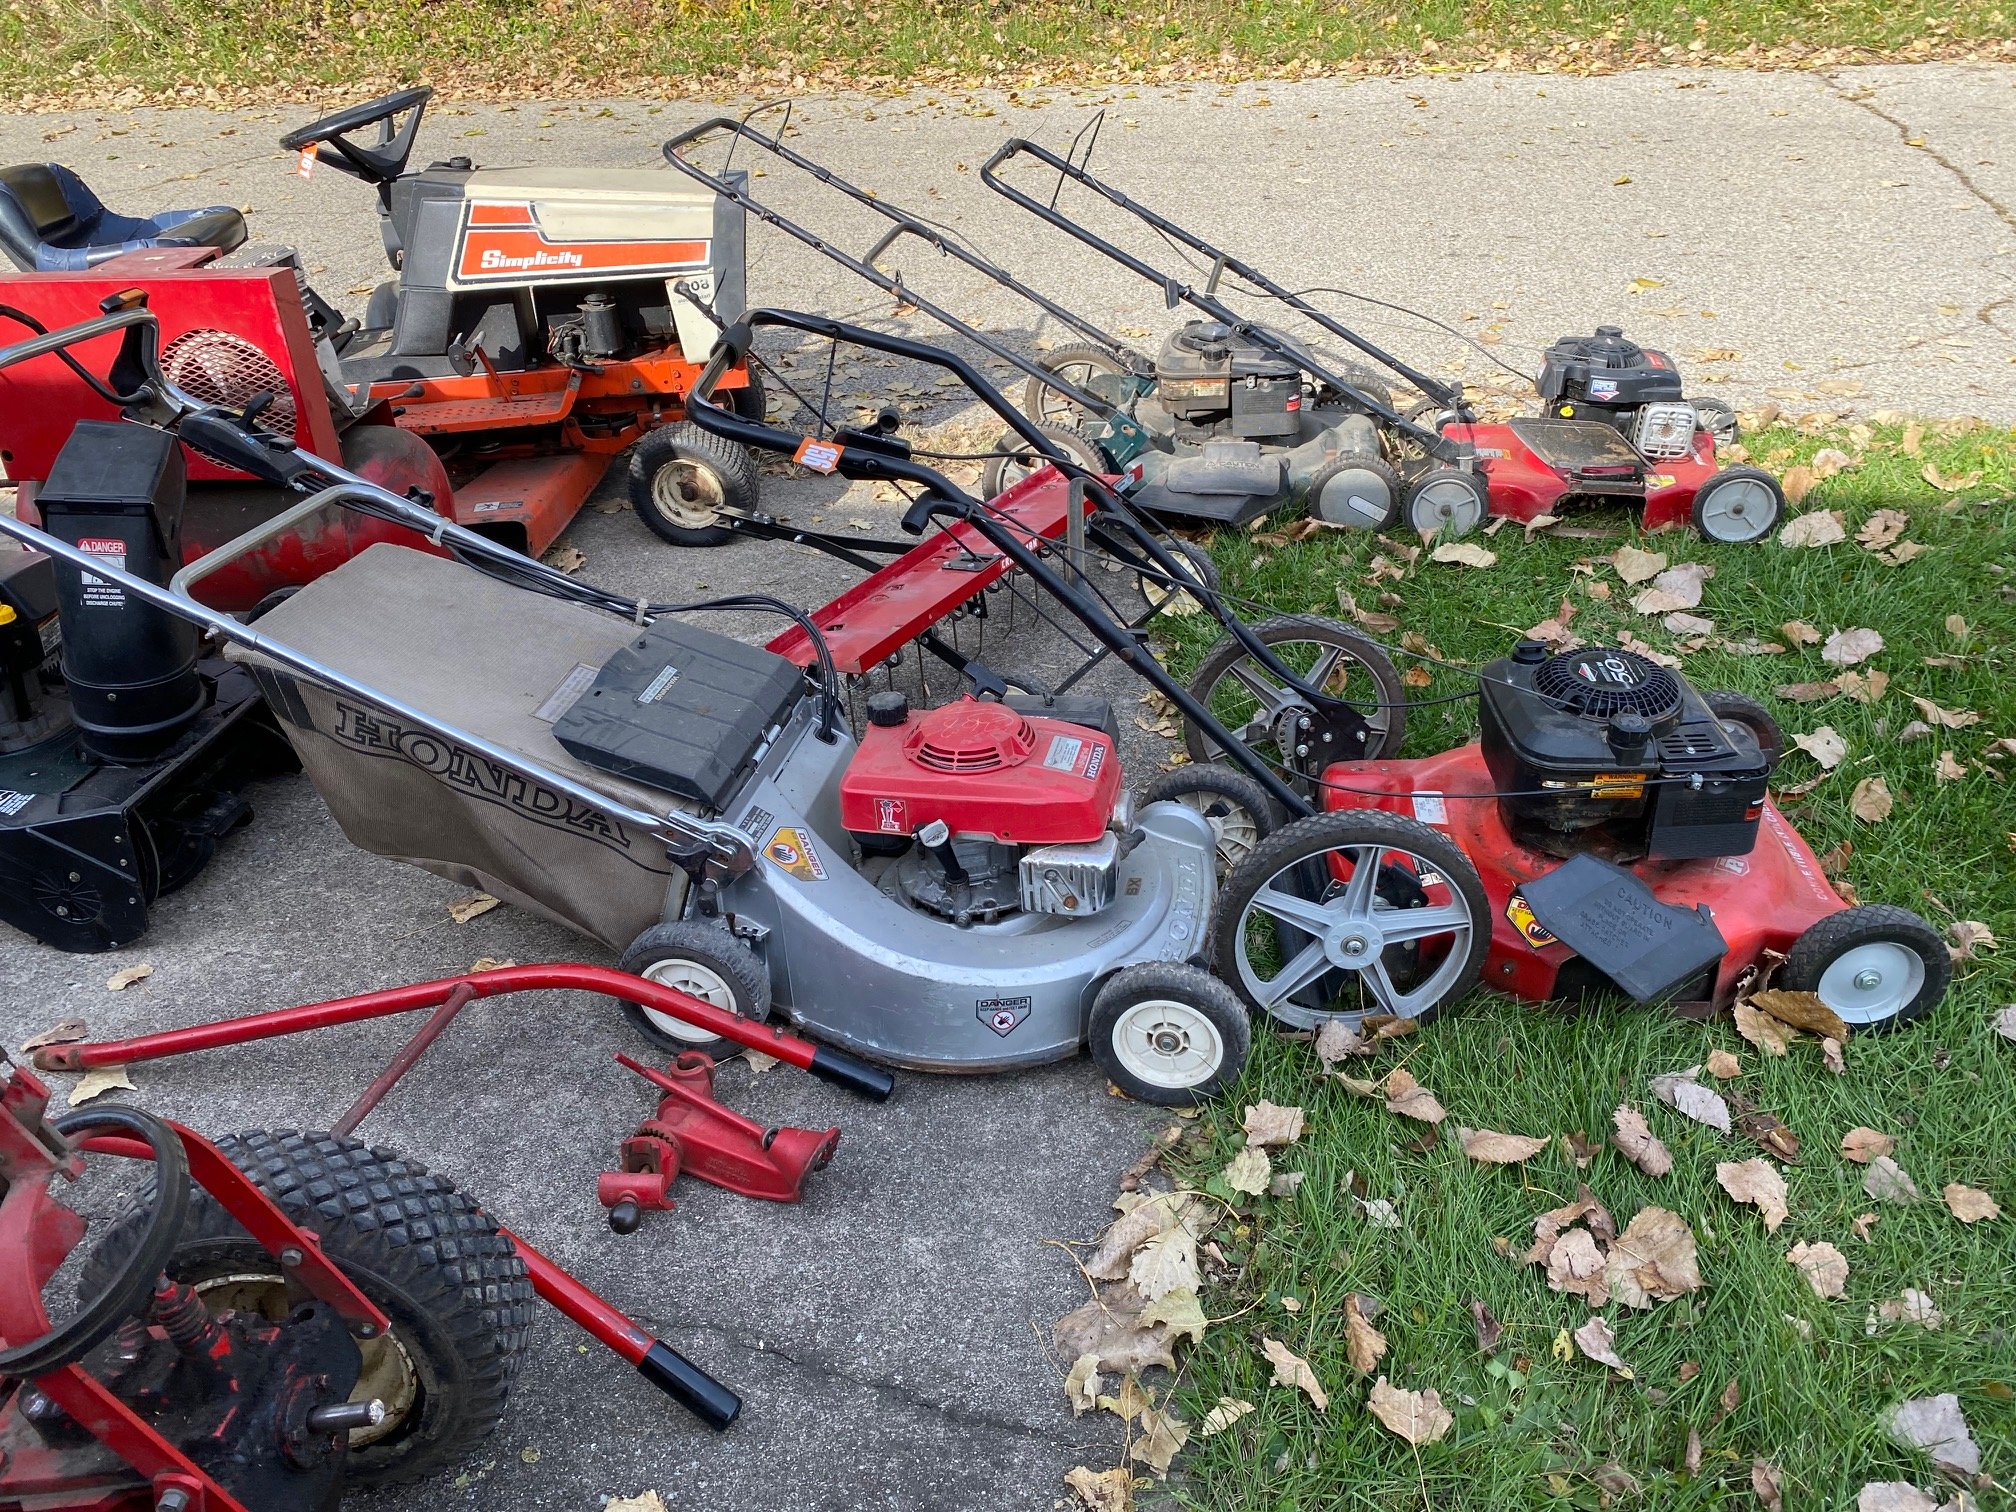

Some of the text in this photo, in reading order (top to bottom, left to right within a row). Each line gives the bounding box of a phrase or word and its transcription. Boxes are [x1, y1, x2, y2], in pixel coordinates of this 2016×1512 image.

[480, 249, 583, 269] Simplicity
[800, 443, 838, 469] 156
[91, 541, 124, 553] DANGER
[335, 701, 632, 849] HONDA
[1087, 745, 1104, 778] HONDA
[798, 832, 823, 876] DANGER
[1616, 887, 1674, 931] CAUTION
[981, 998, 1028, 1007] DANGER
